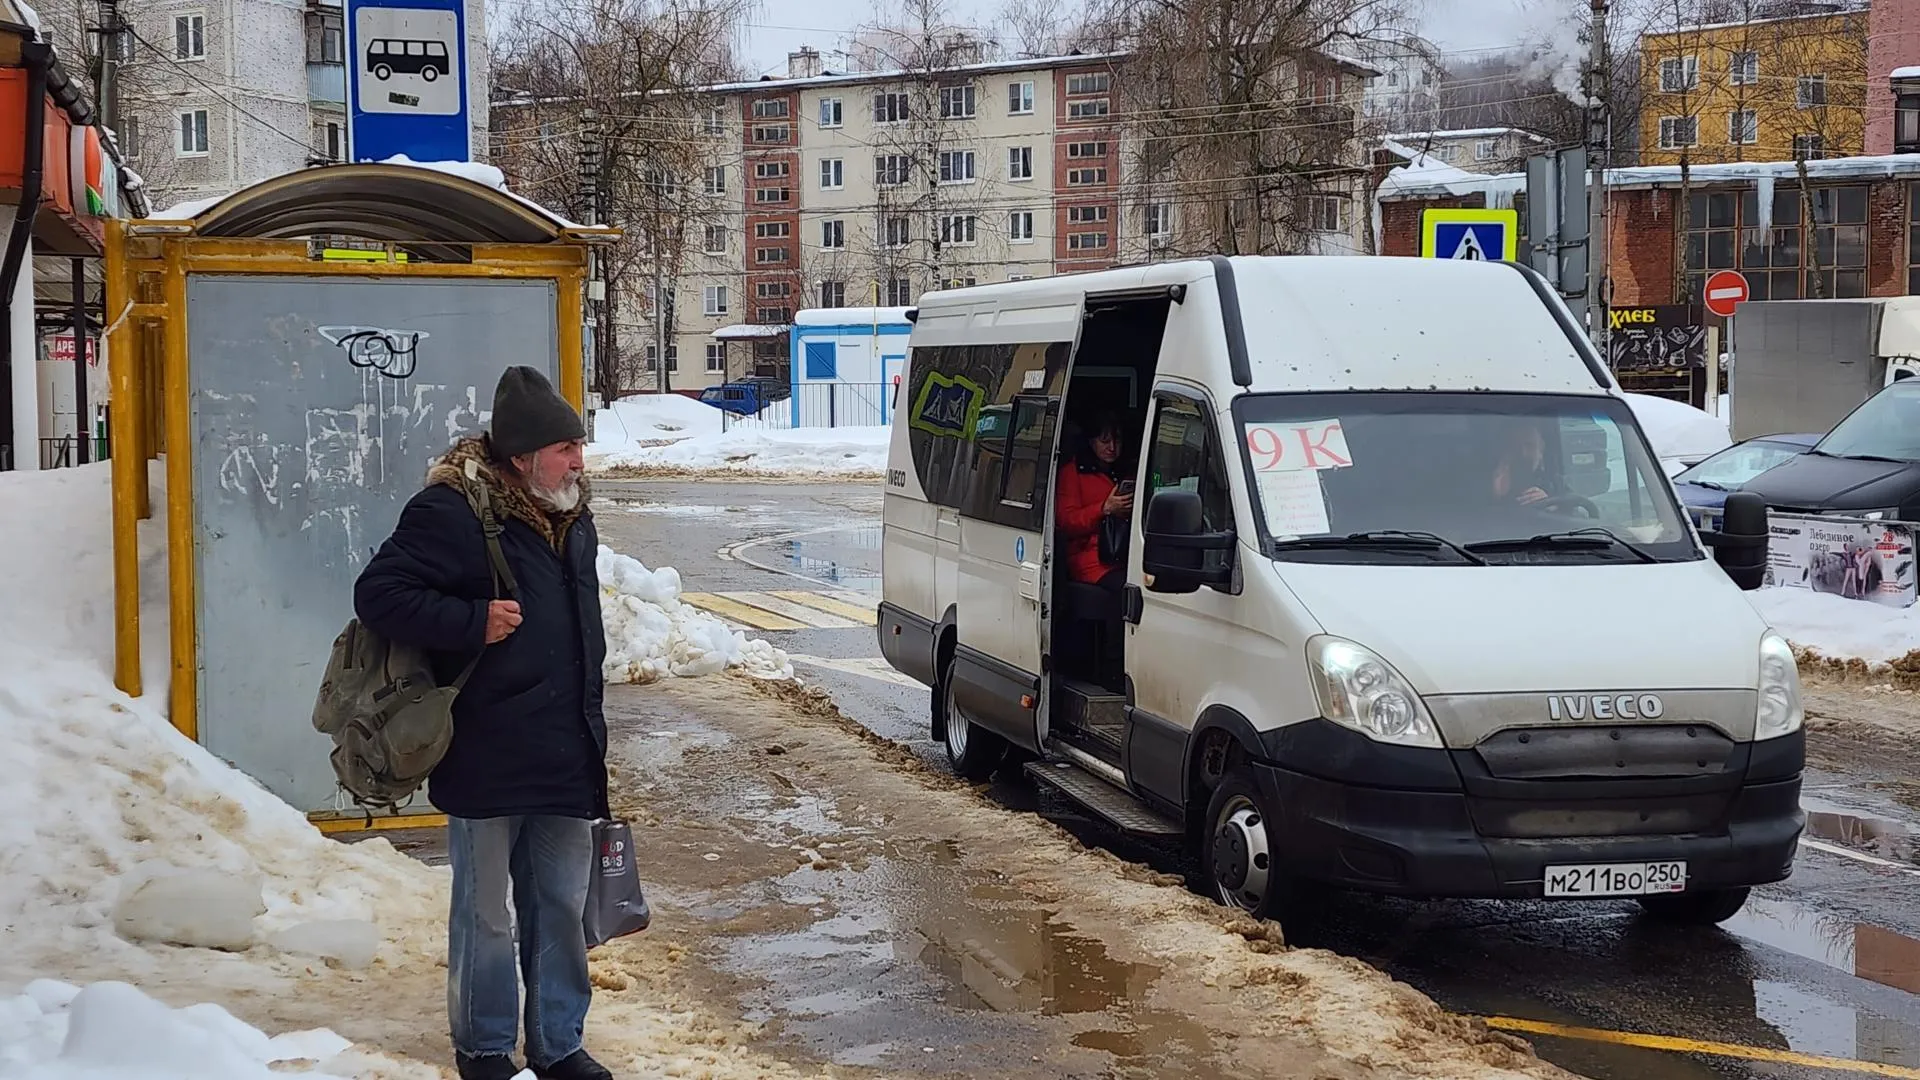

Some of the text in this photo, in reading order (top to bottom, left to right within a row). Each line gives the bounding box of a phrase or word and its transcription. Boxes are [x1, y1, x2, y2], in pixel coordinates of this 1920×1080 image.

[1609, 310, 1656, 329] ХЛЕБ
[56, 340, 93, 353] АРЕА
[1248, 427, 1283, 470] 9
[888, 468, 905, 487] IVECO
[1809, 542, 1831, 555] озеро
[1547, 694, 1664, 720] IVECO
[1550, 864, 1680, 892] М211ВО 250
[1654, 882, 1670, 890] RUS
